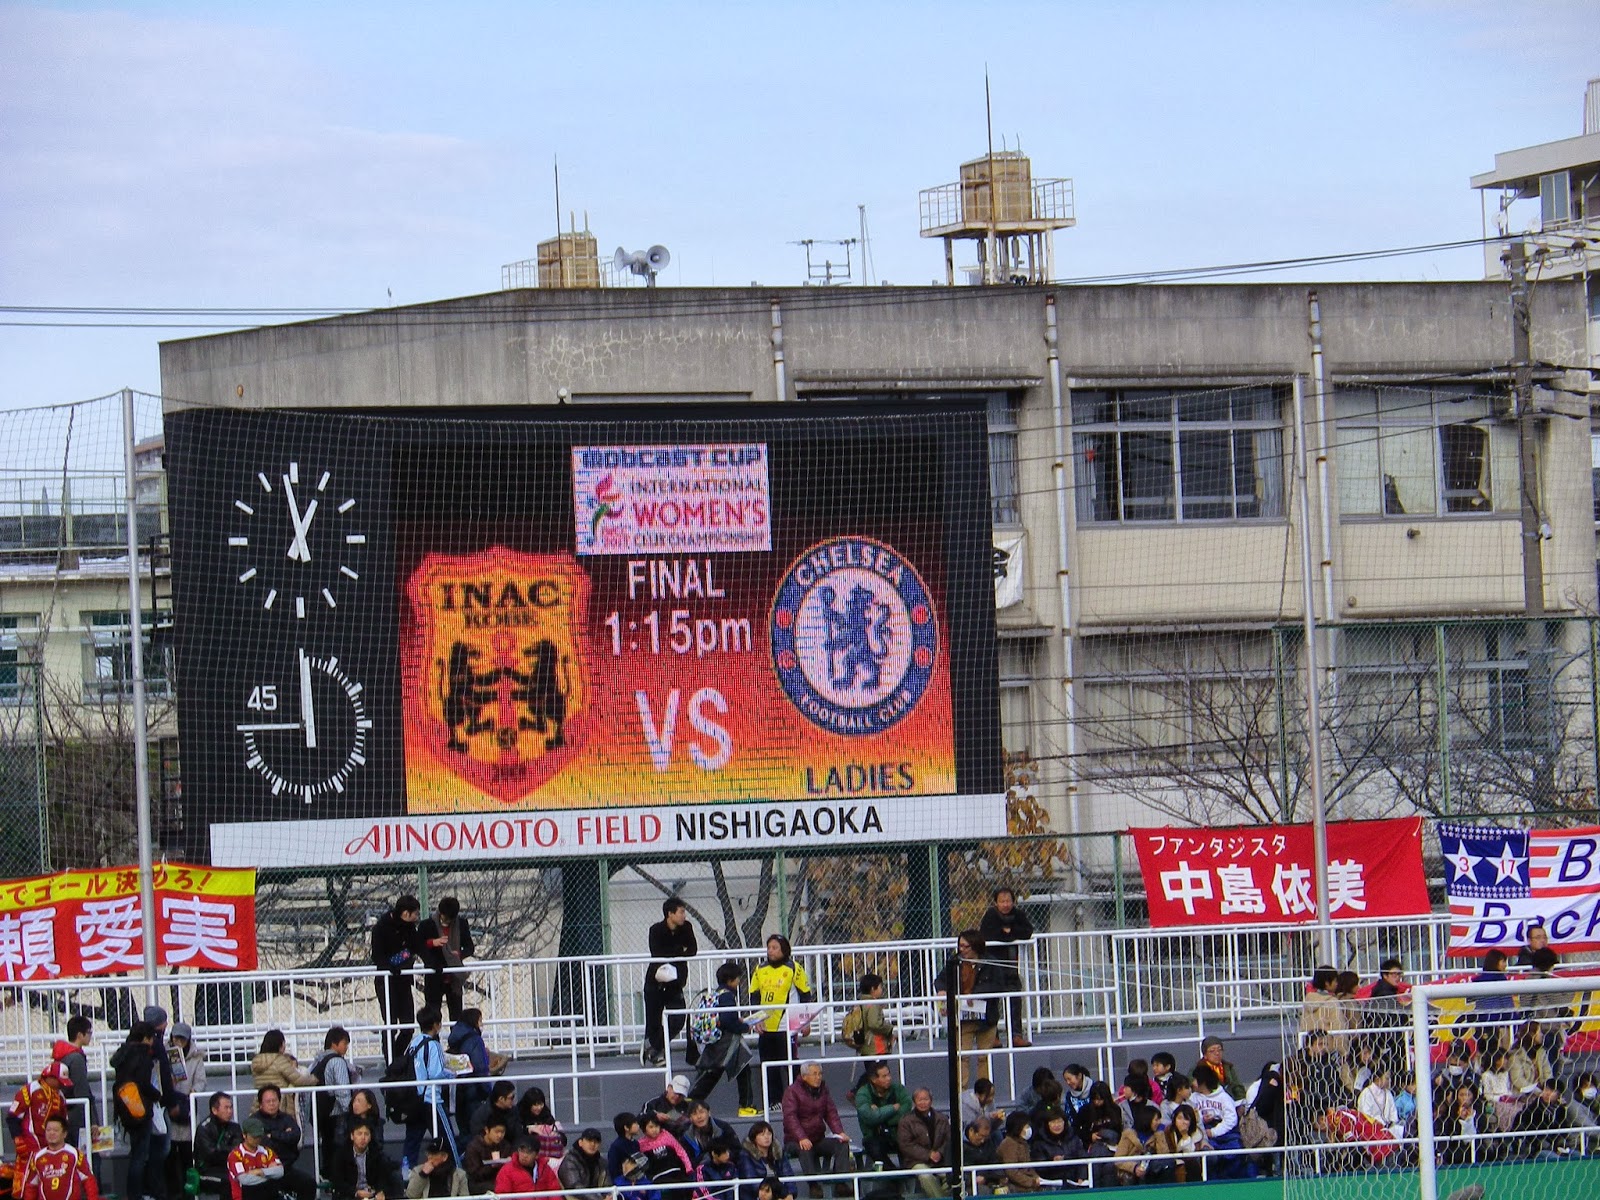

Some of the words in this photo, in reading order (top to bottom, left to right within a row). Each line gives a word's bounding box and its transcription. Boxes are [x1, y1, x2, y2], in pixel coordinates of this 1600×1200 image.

[712, 447, 761, 466] CUP
[631, 479, 762, 494] INTERNATIONAL
[633, 500, 765, 528] WOMEN'S
[627, 558, 726, 600] FINAL
[793, 544, 904, 587] CHELSEA
[441, 580, 560, 610] INAC
[605, 609, 752, 659] 1:15pm
[247, 685, 278, 711] 45
[635, 687, 733, 772] VS
[806, 762, 915, 794] LADIES
[345, 817, 559, 859] AJINOMOTO
[577, 814, 662, 845] FIELD
[676, 805, 884, 841] NISHIGAOKA
[1149, 833, 1286, 859] ファンタジスタ
[1458, 856, 1470, 873] 3
[1499, 859, 1515, 875] 17
[1558, 838, 1600, 883] B
[0, 872, 213, 906] でゴール決めろ!
[1159, 858, 1367, 916] 中島依美
[764, 991, 775, 1003] 18
[51, 1177, 60, 1191] 9
